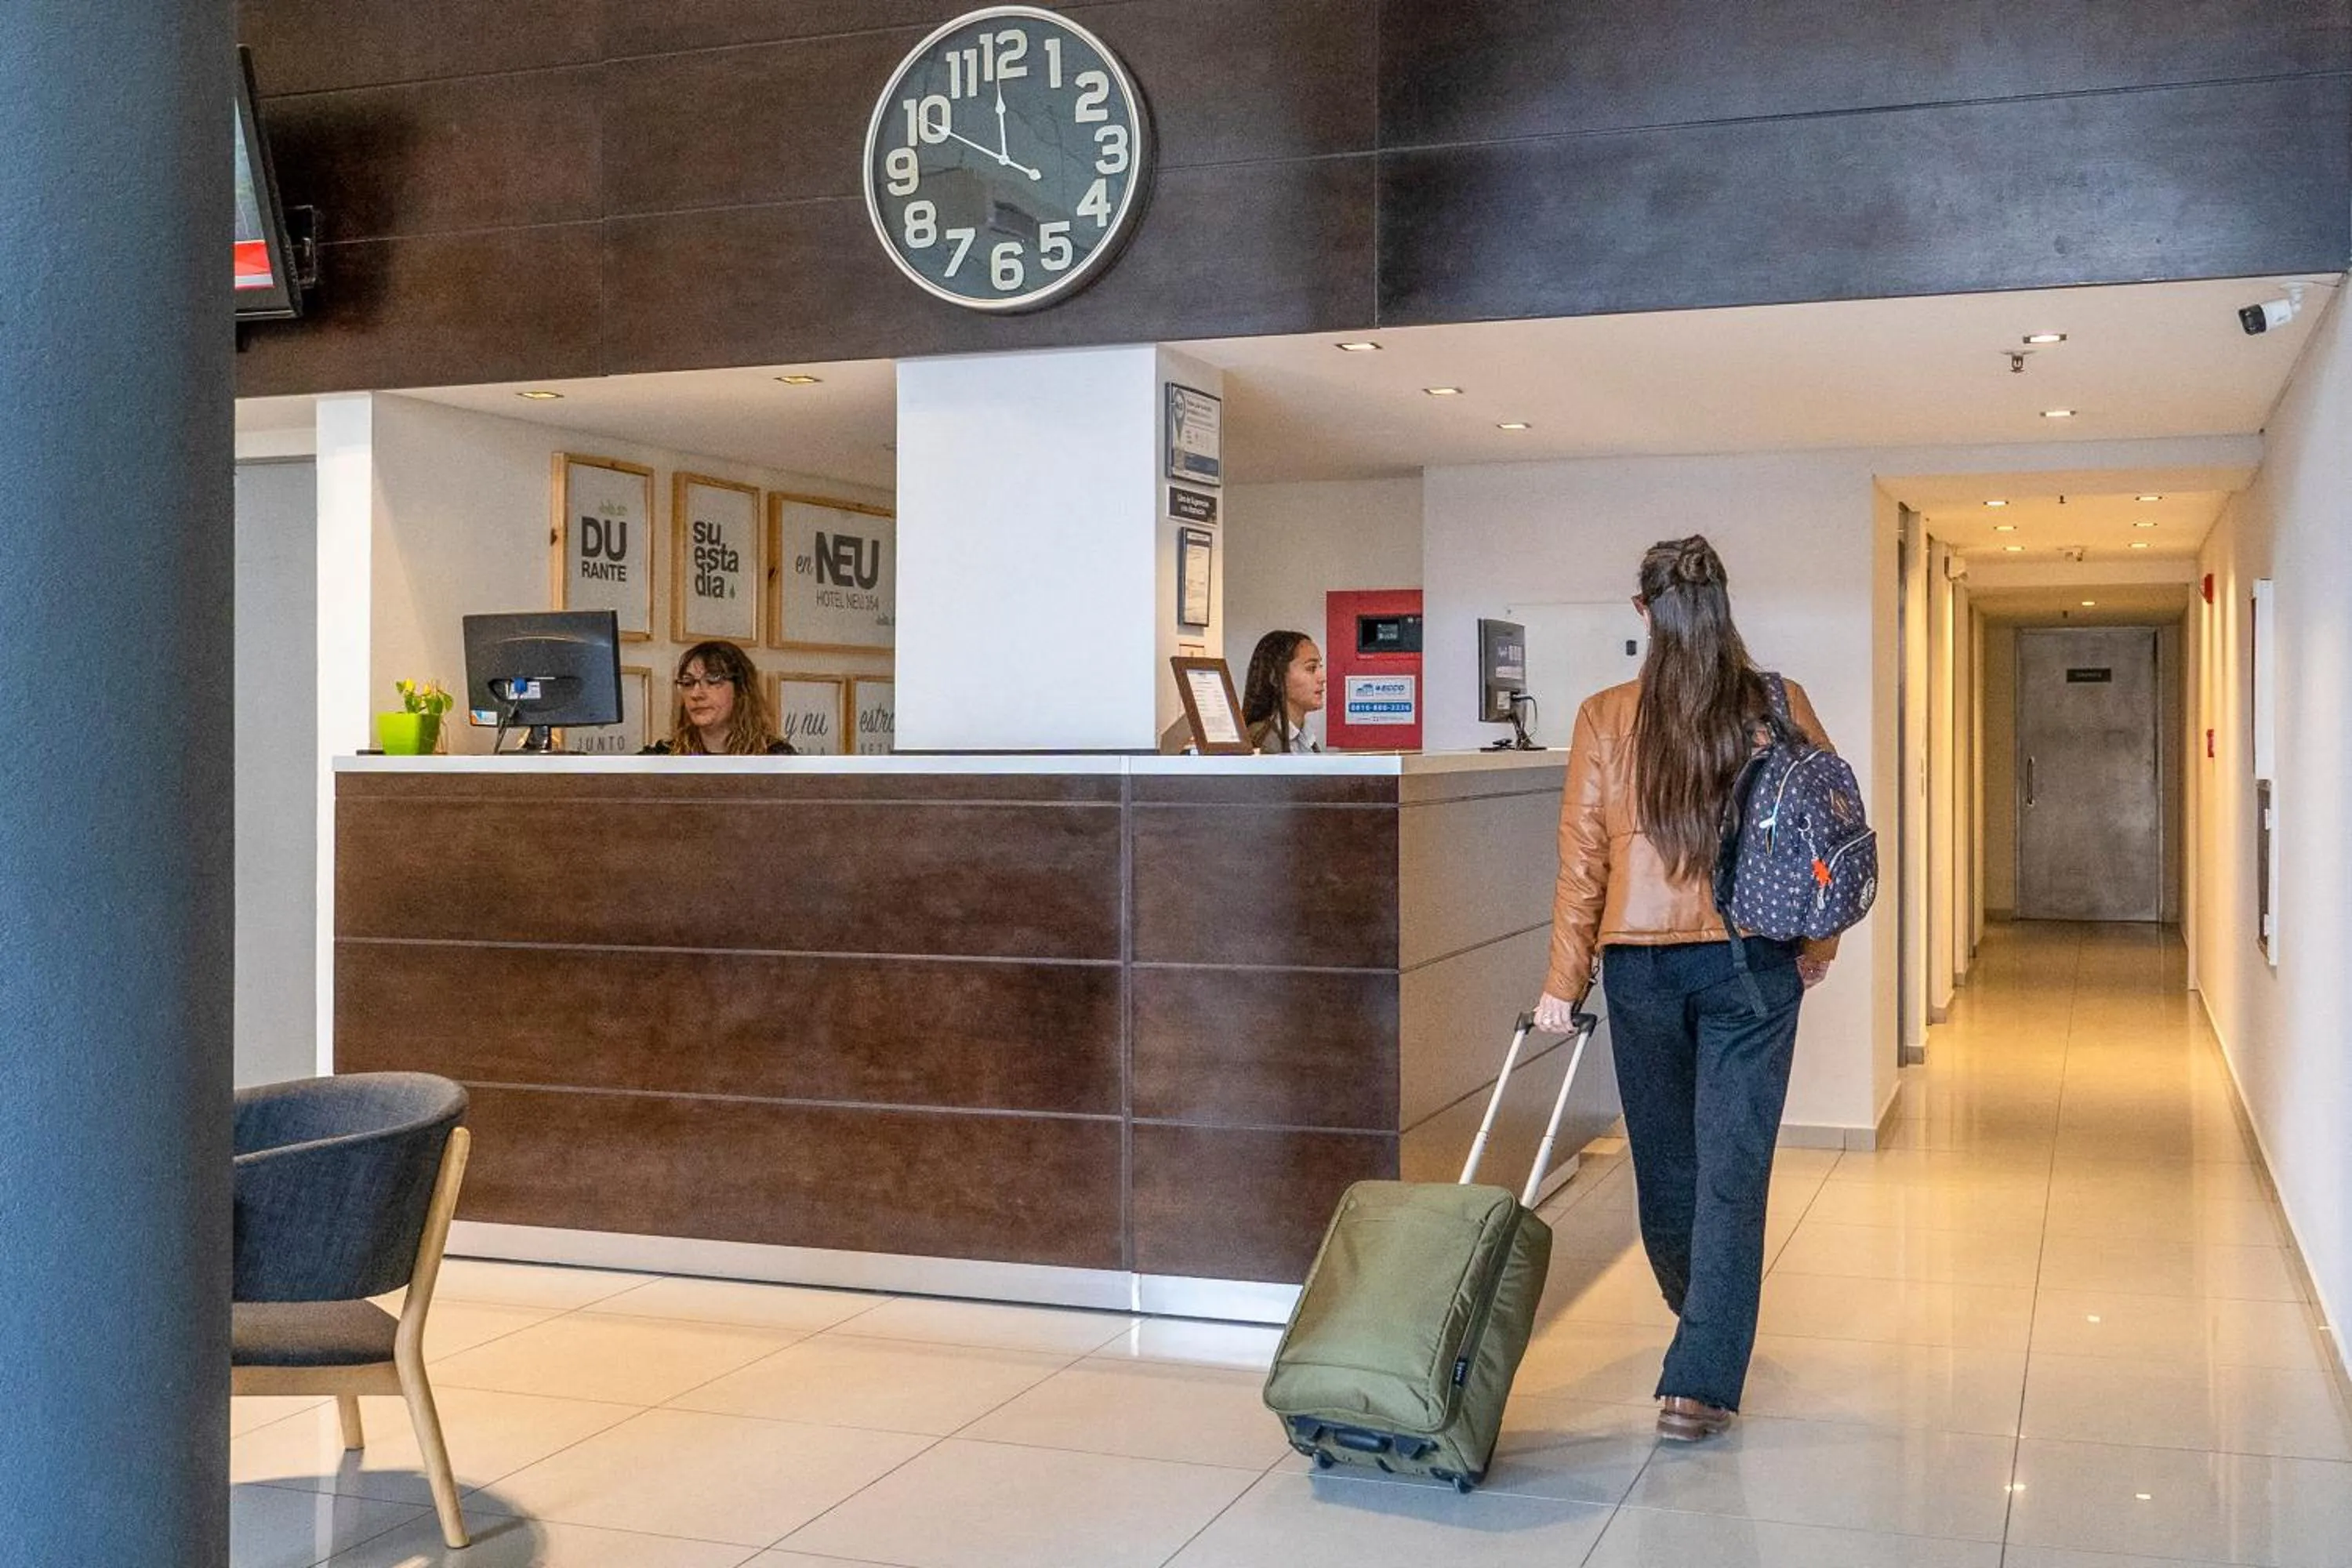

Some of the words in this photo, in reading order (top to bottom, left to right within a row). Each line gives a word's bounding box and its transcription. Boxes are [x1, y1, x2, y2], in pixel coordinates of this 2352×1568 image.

[946, 49, 978, 100] 11
[979, 29, 1028, 82] 12
[1044, 38, 1062, 89] 1
[902, 95, 952, 147] 10
[1075, 71, 1109, 123] 2
[885, 147, 919, 197] 9
[1094, 125, 1128, 175] 3
[904, 200, 937, 249] 8
[1076, 178, 1111, 228] 4
[943, 227, 975, 278] 7
[990, 241, 1025, 291] 6
[1039, 220, 1073, 271] 5
[581, 516, 627, 561] DU
[693, 521, 721, 546] su
[695, 543, 739, 573] esta
[581, 561, 627, 582] RANTE
[795, 554, 813, 575] en
[815, 531, 880, 590] NEU
[815, 589, 844, 609] HOTEL
[576, 735, 626, 752] JUNTO
[785, 711, 797, 739] y
[800, 711, 828, 735] nu
